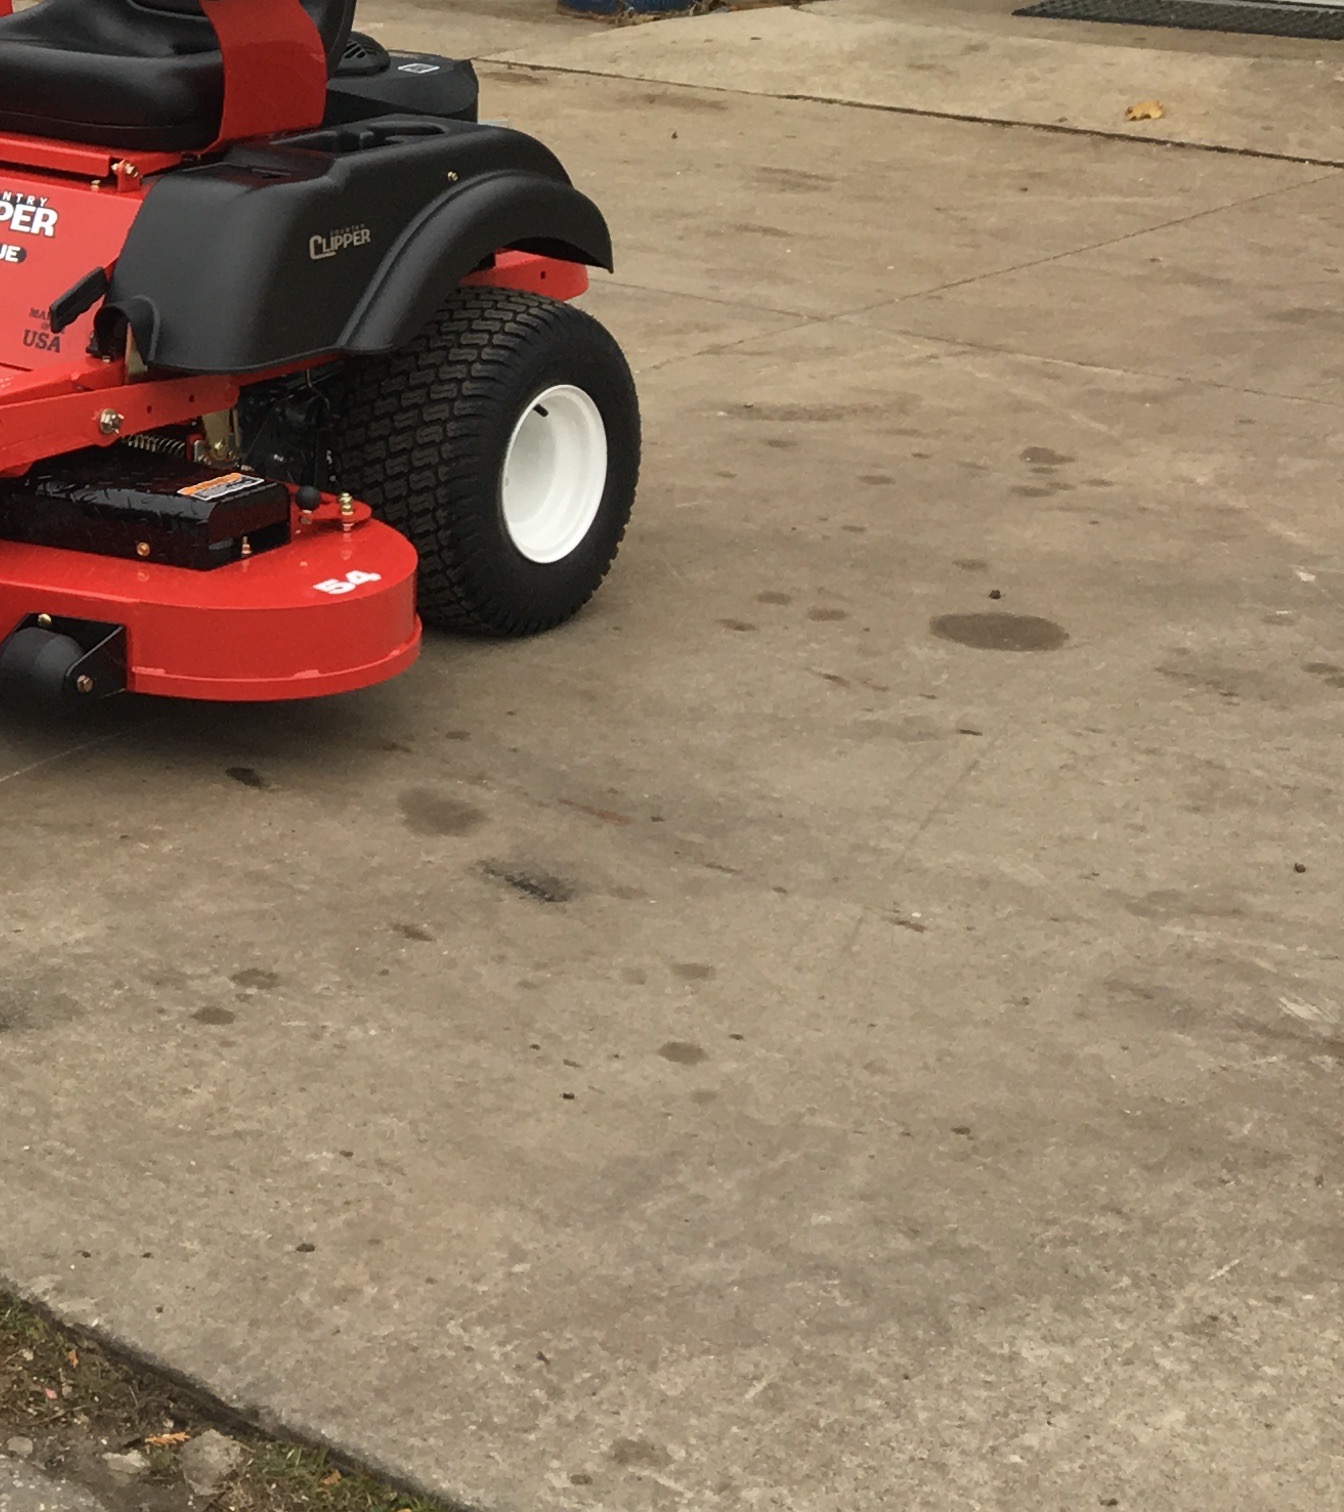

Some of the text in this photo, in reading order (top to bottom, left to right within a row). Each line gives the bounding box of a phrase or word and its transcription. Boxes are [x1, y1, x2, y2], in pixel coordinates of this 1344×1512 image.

[309, 229, 371, 260] CLIPPER
[23, 329, 61, 354] USA
[312, 570, 382, 595] 54
